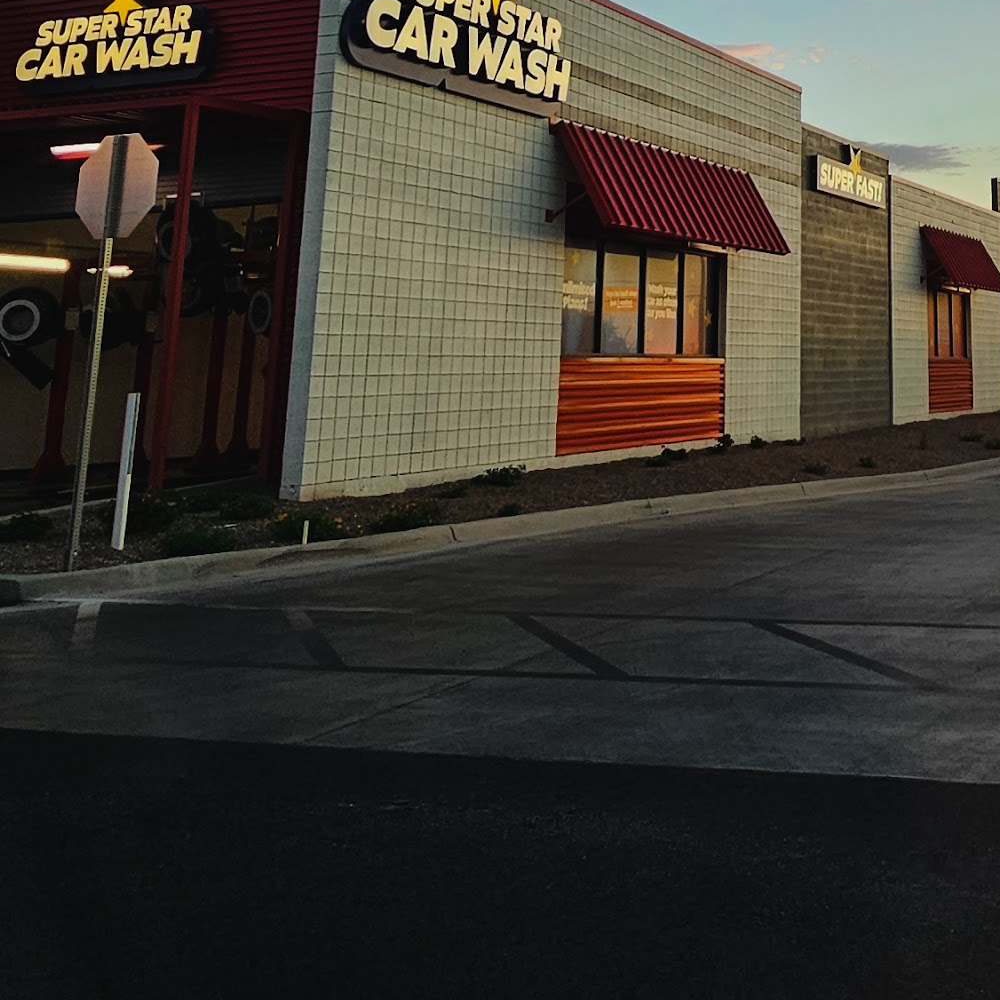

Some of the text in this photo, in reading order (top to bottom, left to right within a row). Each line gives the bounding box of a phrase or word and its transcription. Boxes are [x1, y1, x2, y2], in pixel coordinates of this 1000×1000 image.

[35, 5, 192, 47] SUPER STAR
[496, 0, 563, 53] STAR
[15, 30, 202, 81] CAR WASH
[468, 25, 571, 102] WASH
[820, 162, 883, 202] SUPER FAST!
